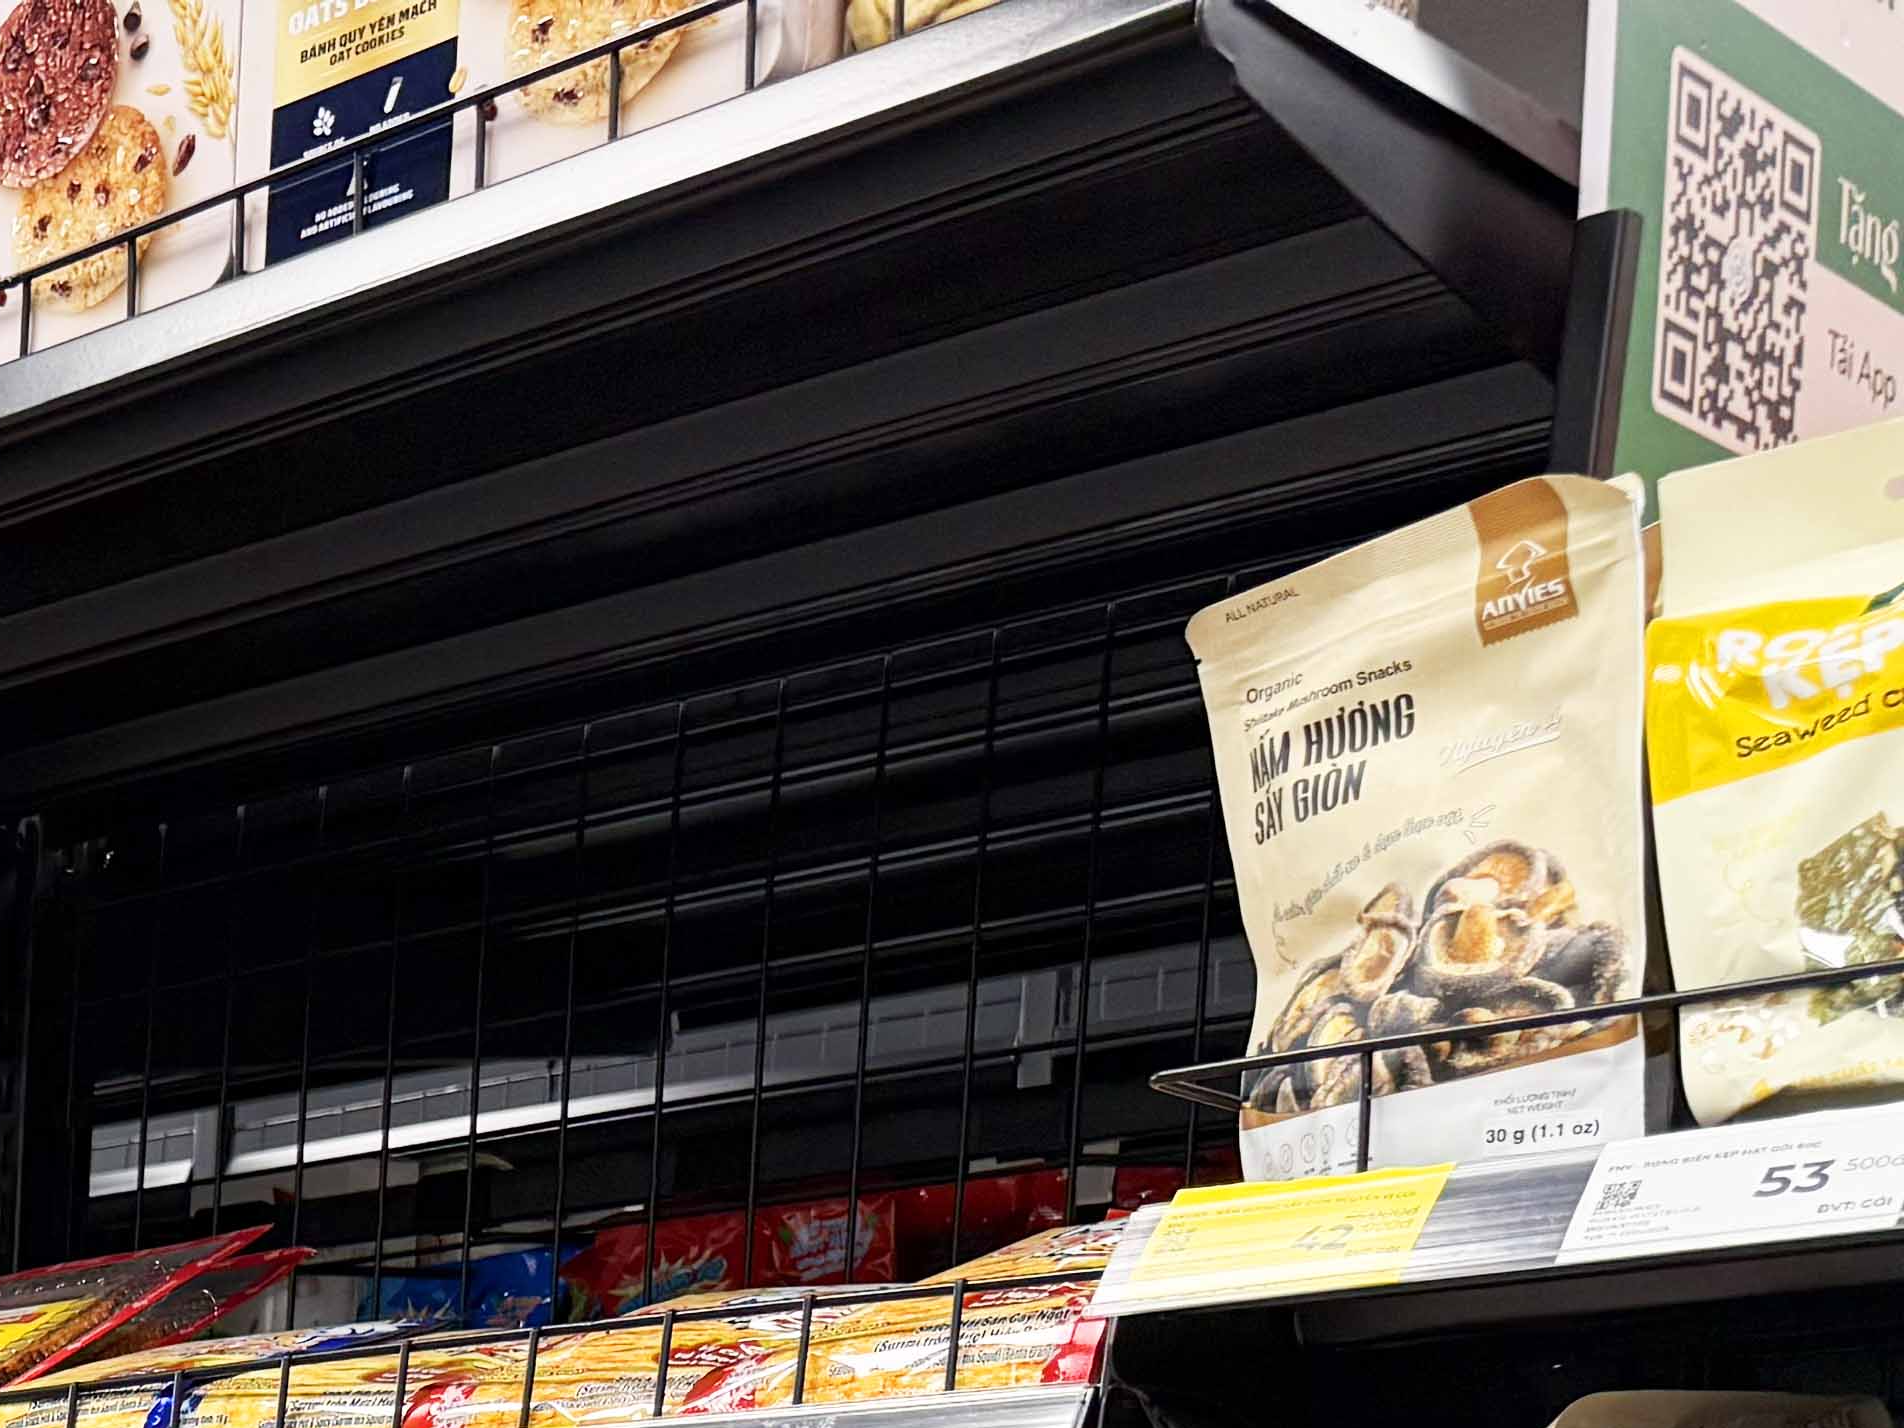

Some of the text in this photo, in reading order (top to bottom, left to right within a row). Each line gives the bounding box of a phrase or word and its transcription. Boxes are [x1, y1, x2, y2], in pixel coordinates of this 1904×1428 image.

[1836, 178, 1899, 292] Tặng
[1827, 329, 1897, 403] Tải App
[1224, 605, 1246, 624] ALL
[1246, 671, 1303, 704] Organic
[1356, 658, 1412, 686] Snacks
[1303, 693, 1415, 767] HƯƠNG
[1734, 694, 1871, 759] Seaweed
[1292, 760, 1367, 823] GIÒN
[1485, 1117, 1601, 1146] 30 g (1.1 oz)
[1753, 1160, 1835, 1197] 53
